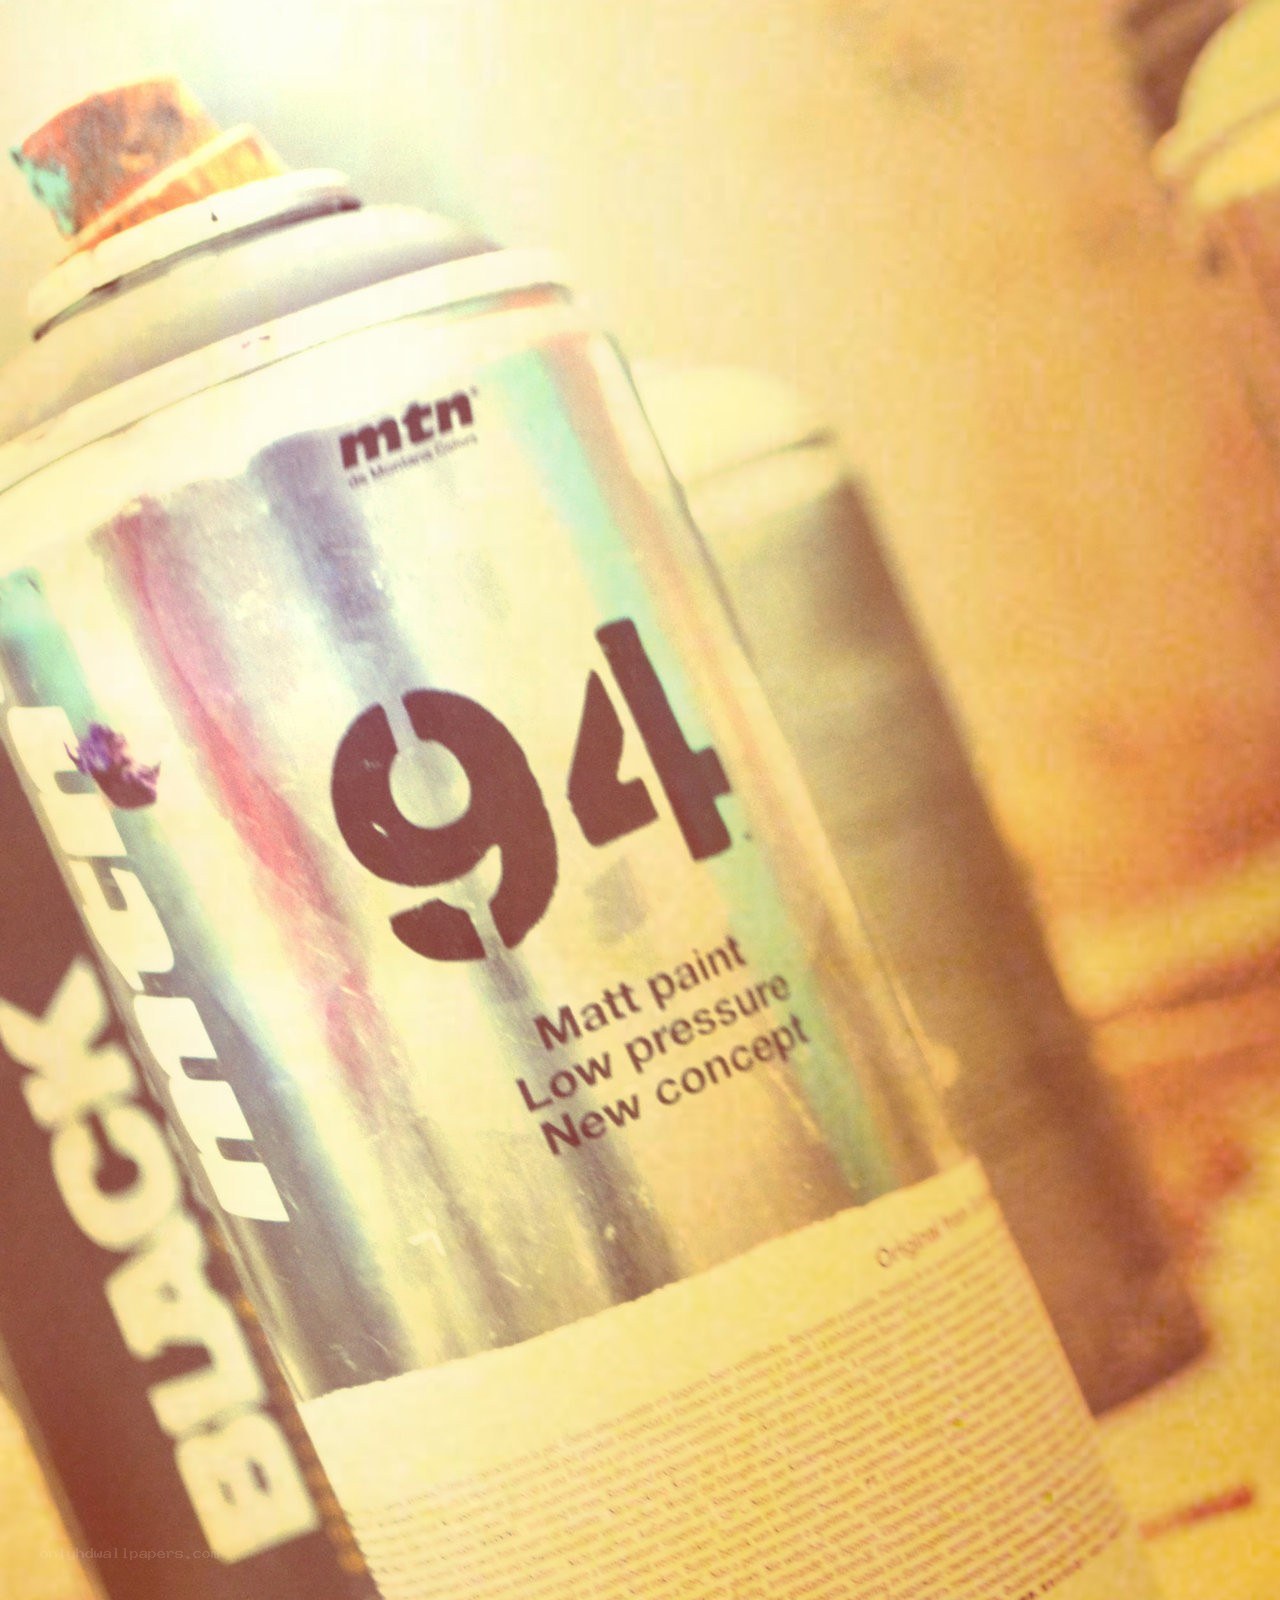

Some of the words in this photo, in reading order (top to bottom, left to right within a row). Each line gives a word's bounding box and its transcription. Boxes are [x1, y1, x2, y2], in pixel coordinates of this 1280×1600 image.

[339, 389, 474, 470] mtn
[330, 616, 734, 963] 94
[515, 1050, 614, 1113] Low
[623, 973, 792, 1074] pressure
[532, 1003, 642, 1052] Matt
[646, 933, 747, 1012] paint
[539, 1093, 641, 1156] New
[655, 1011, 811, 1106] concept
[0, 953, 320, 1568] BLACK
